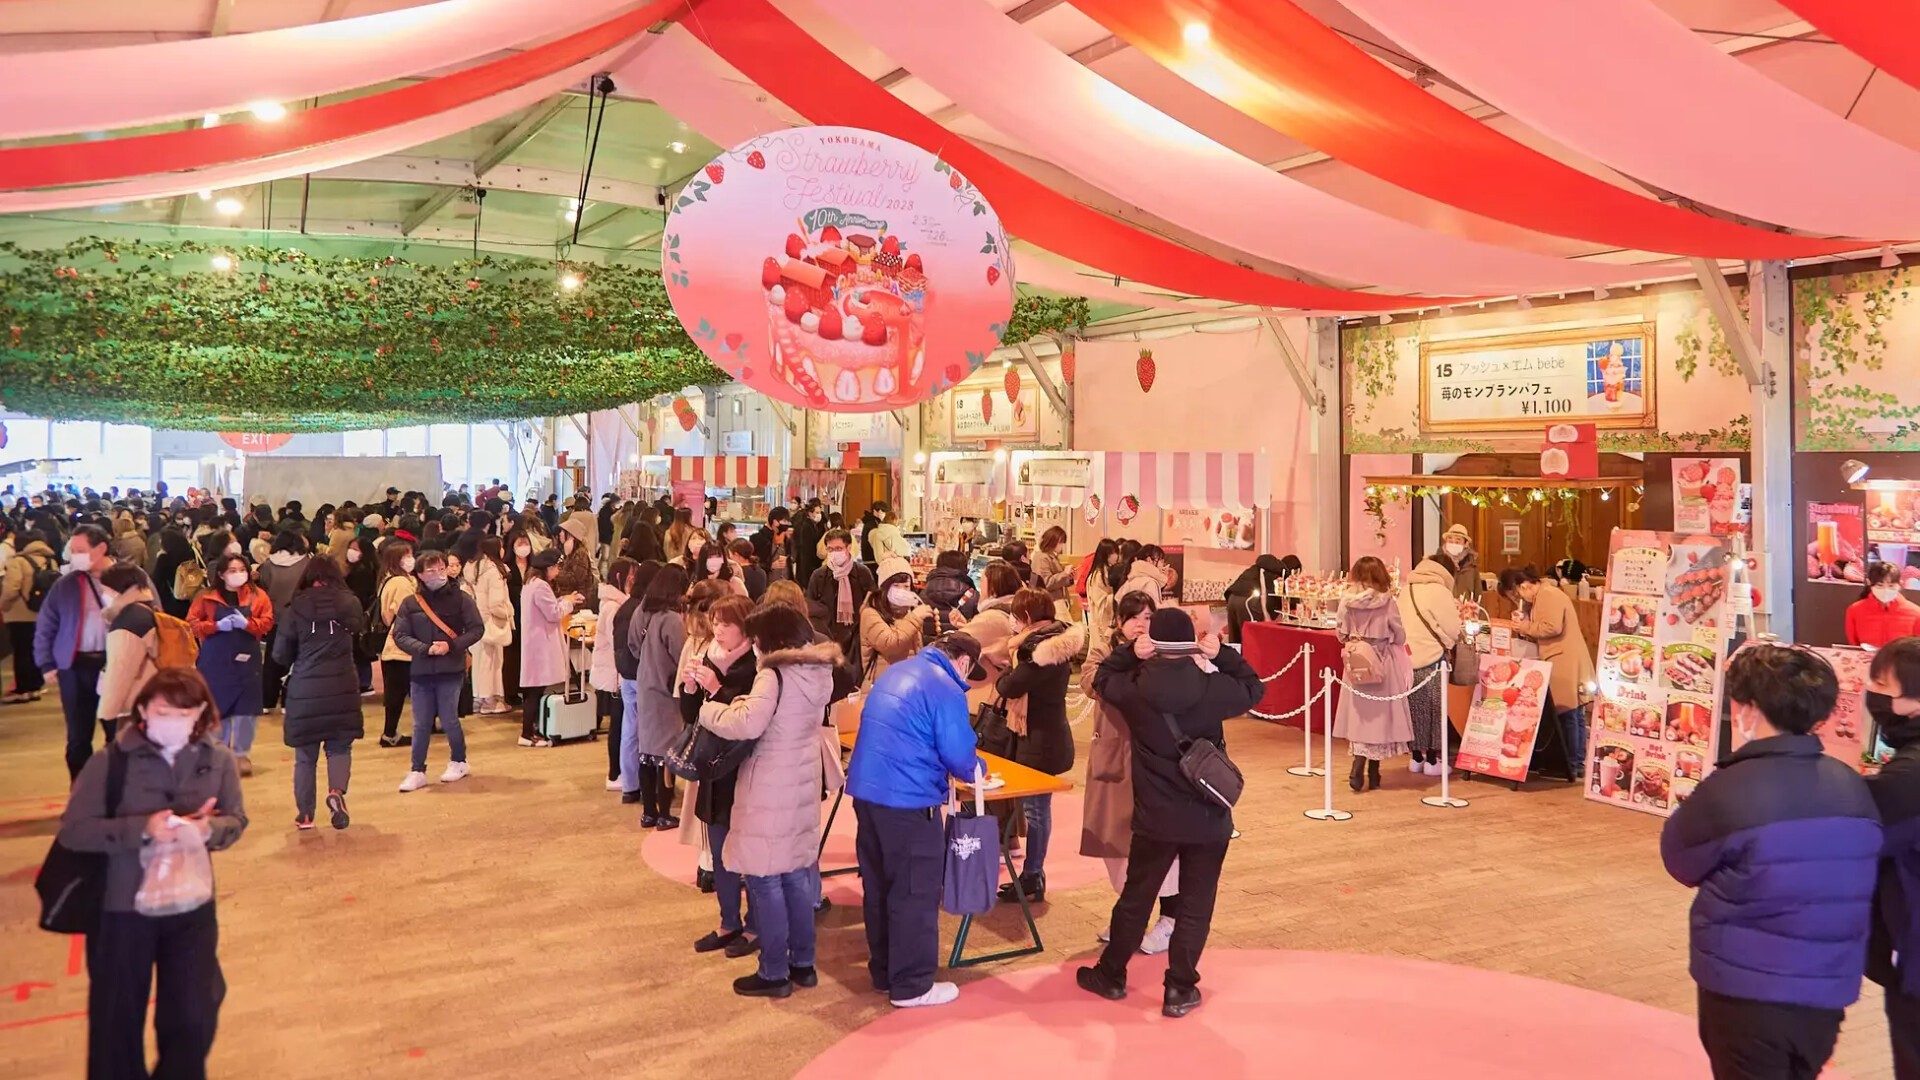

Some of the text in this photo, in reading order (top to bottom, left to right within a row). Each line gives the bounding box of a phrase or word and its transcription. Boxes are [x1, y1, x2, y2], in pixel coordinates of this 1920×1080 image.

[819, 135, 882, 152] YOKOHAMA
[776, 133, 921, 192] Strawberry
[783, 175, 885, 210] Festival
[809, 208, 838, 231] 10th
[1436, 363, 1453, 378] 15
[1537, 356, 1565, 370] bebe
[1441, 383, 1552, 401] 苺のモンブランパフェ
[1521, 398, 1572, 415] ¥1,100
[242, 433, 272, 445] EXIT
[1617, 686, 1647, 700] Drink
[1645, 750, 1666, 760] Drink
[1649, 744, 1663, 752] Hot
